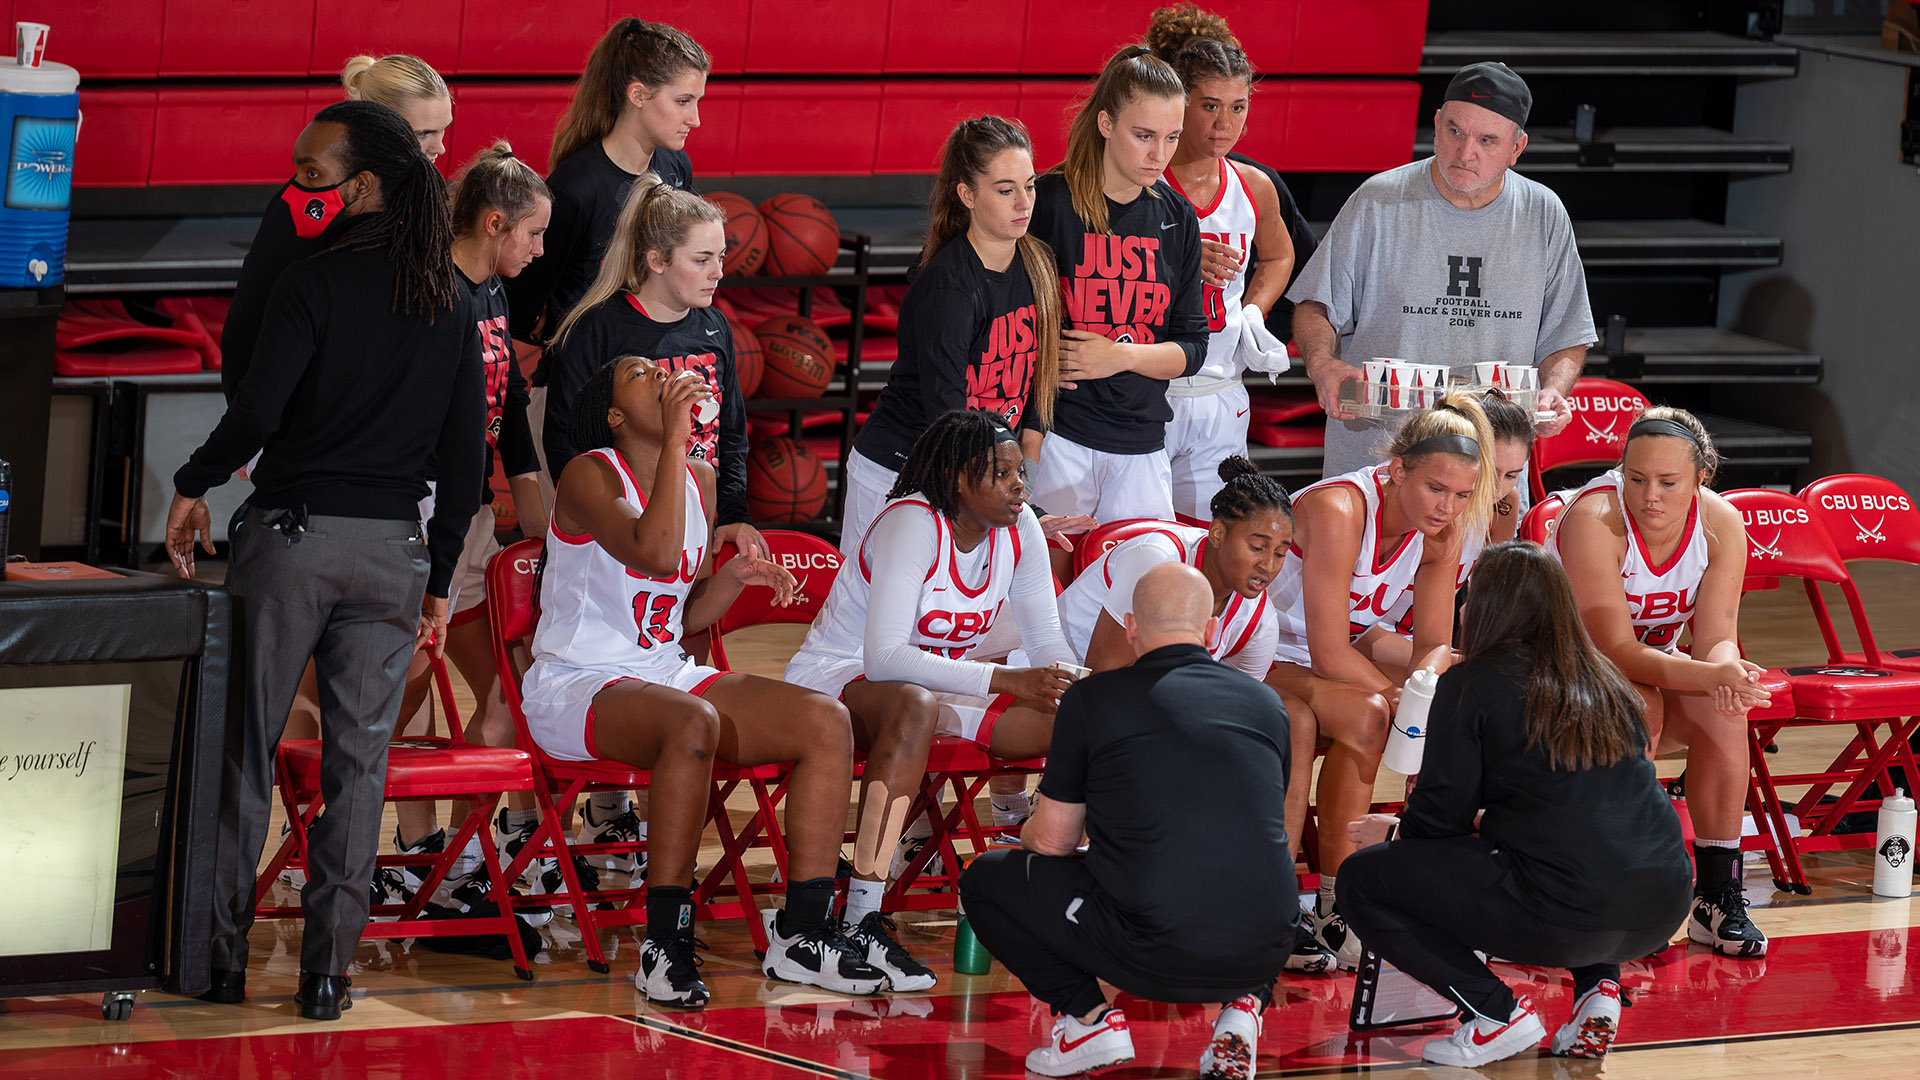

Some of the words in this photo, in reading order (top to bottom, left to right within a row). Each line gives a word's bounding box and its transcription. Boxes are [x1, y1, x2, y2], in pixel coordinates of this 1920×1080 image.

[1075, 232, 1160, 282] JUST
[1446, 255, 1483, 298] H
[1058, 276, 1171, 326] NEVER
[1435, 297, 1491, 308] FOOTBALL
[1402, 306, 1438, 315] BLACK
[1441, 307, 1449, 315] &
[1451, 308, 1491, 318] SILVER
[1494, 310, 1523, 319] GAME
[1449, 318, 1475, 327] 2016
[1566, 396, 1589, 412] BU
[1592, 396, 1645, 412] BUCS
[1821, 495, 1857, 510] CBU
[1861, 495, 1911, 511] BUCS
[1756, 508, 1810, 526] BUCS
[781, 553, 840, 569] BUCS
[632, 590, 679, 650] 13
[917, 597, 1006, 643] CBU
[8, 740, 97, 781] yourself
[1602, 982, 1616, 992] NIKE
[1110, 1014, 1126, 1023] NIKE
